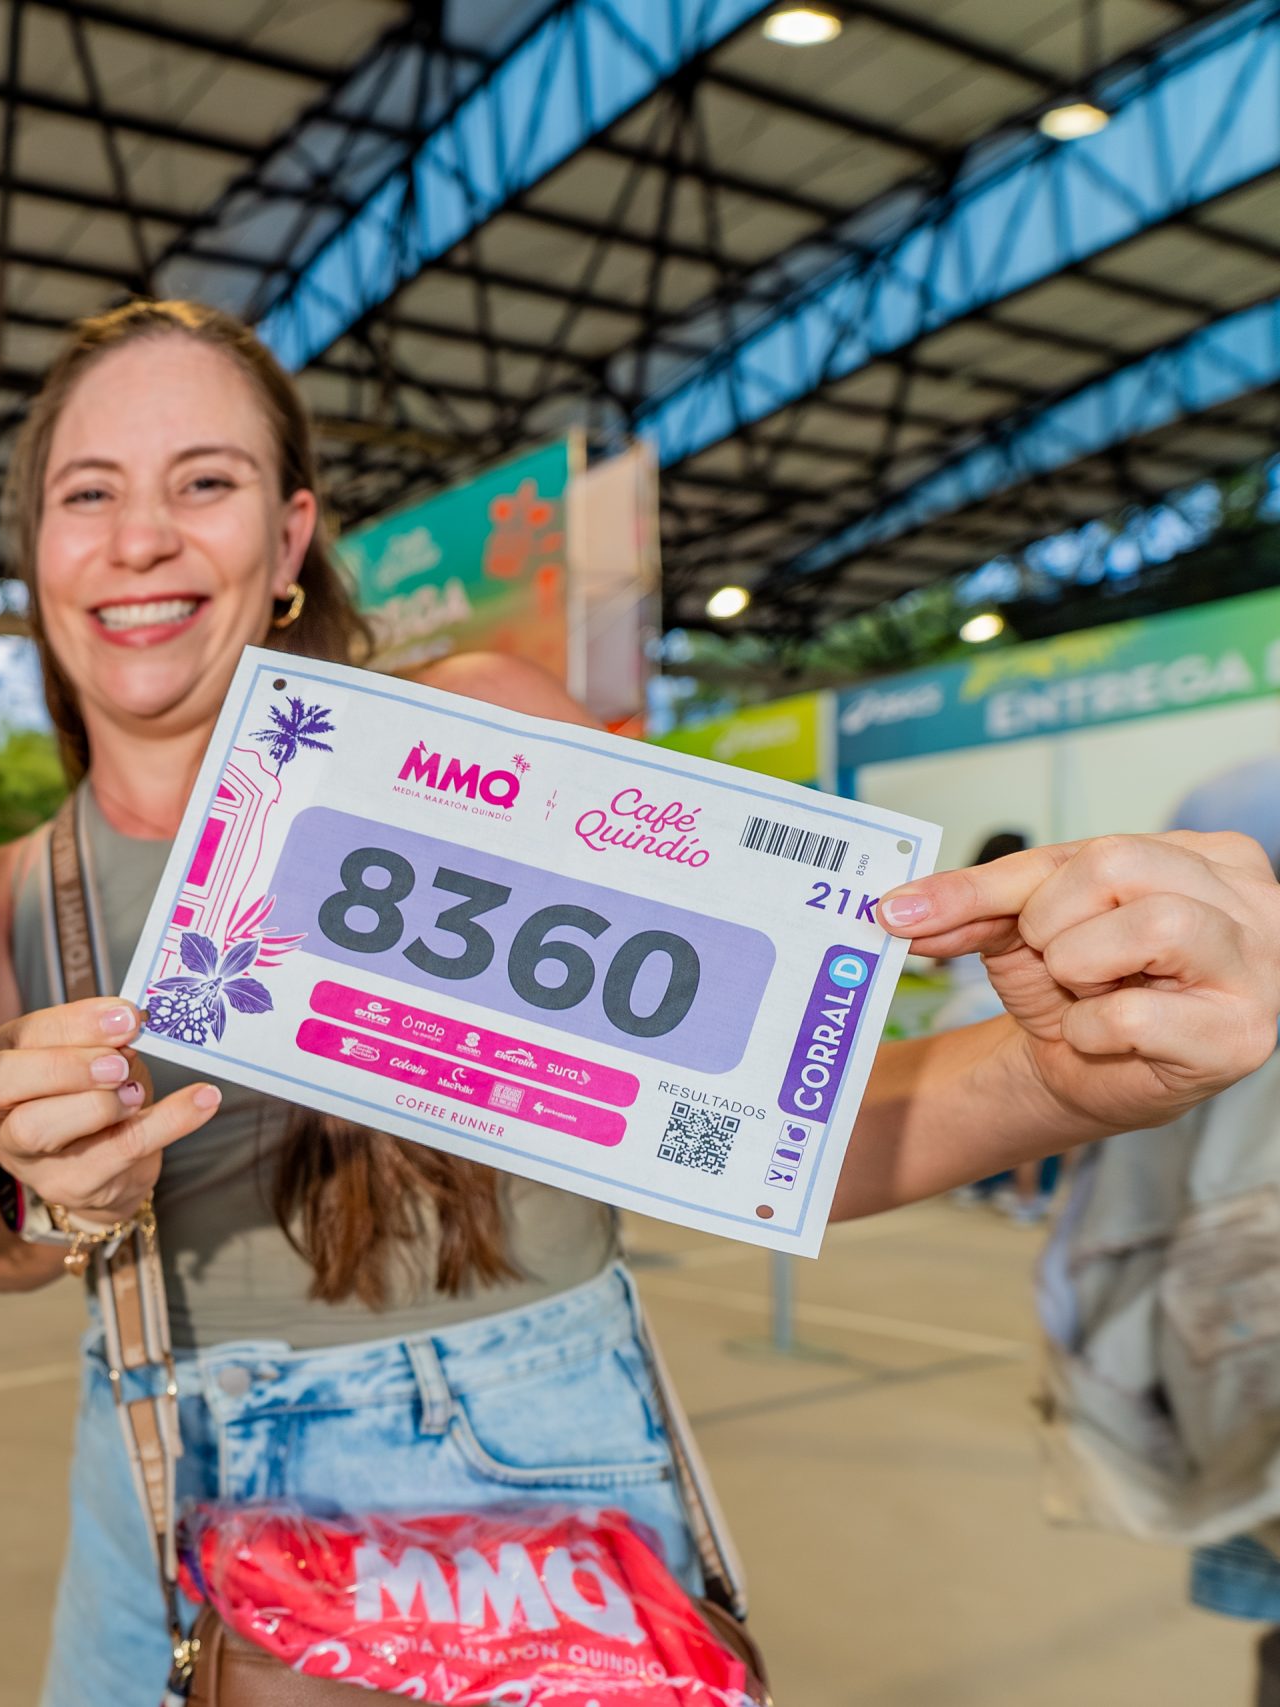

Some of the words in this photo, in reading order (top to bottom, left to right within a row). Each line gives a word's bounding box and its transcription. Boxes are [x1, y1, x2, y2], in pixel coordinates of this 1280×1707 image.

[392, 785, 420, 798] MEDIA
[397, 746, 520, 810] MMQ
[546, 800, 557, 810] By
[610, 788, 702, 833] Café
[575, 809, 710, 868] Quindío
[855, 853, 870, 877] 8360
[805, 881, 880, 924] 21K
[318, 847, 700, 1038] 8360
[414, 1018, 445, 1037] mdp
[793, 990, 856, 1112] CORRAL
[833, 958, 863, 982] D
[494, 1050, 538, 1070] Electrolife
[546, 1063, 578, 1080] sura
[437, 1077, 474, 1095] MacPollo
[657, 1080, 767, 1120] RESULTADOS
[395, 1094, 446, 1119] COFFEE
[450, 1111, 505, 1137] RUNNER
[354, 1541, 647, 1646] MMQ
